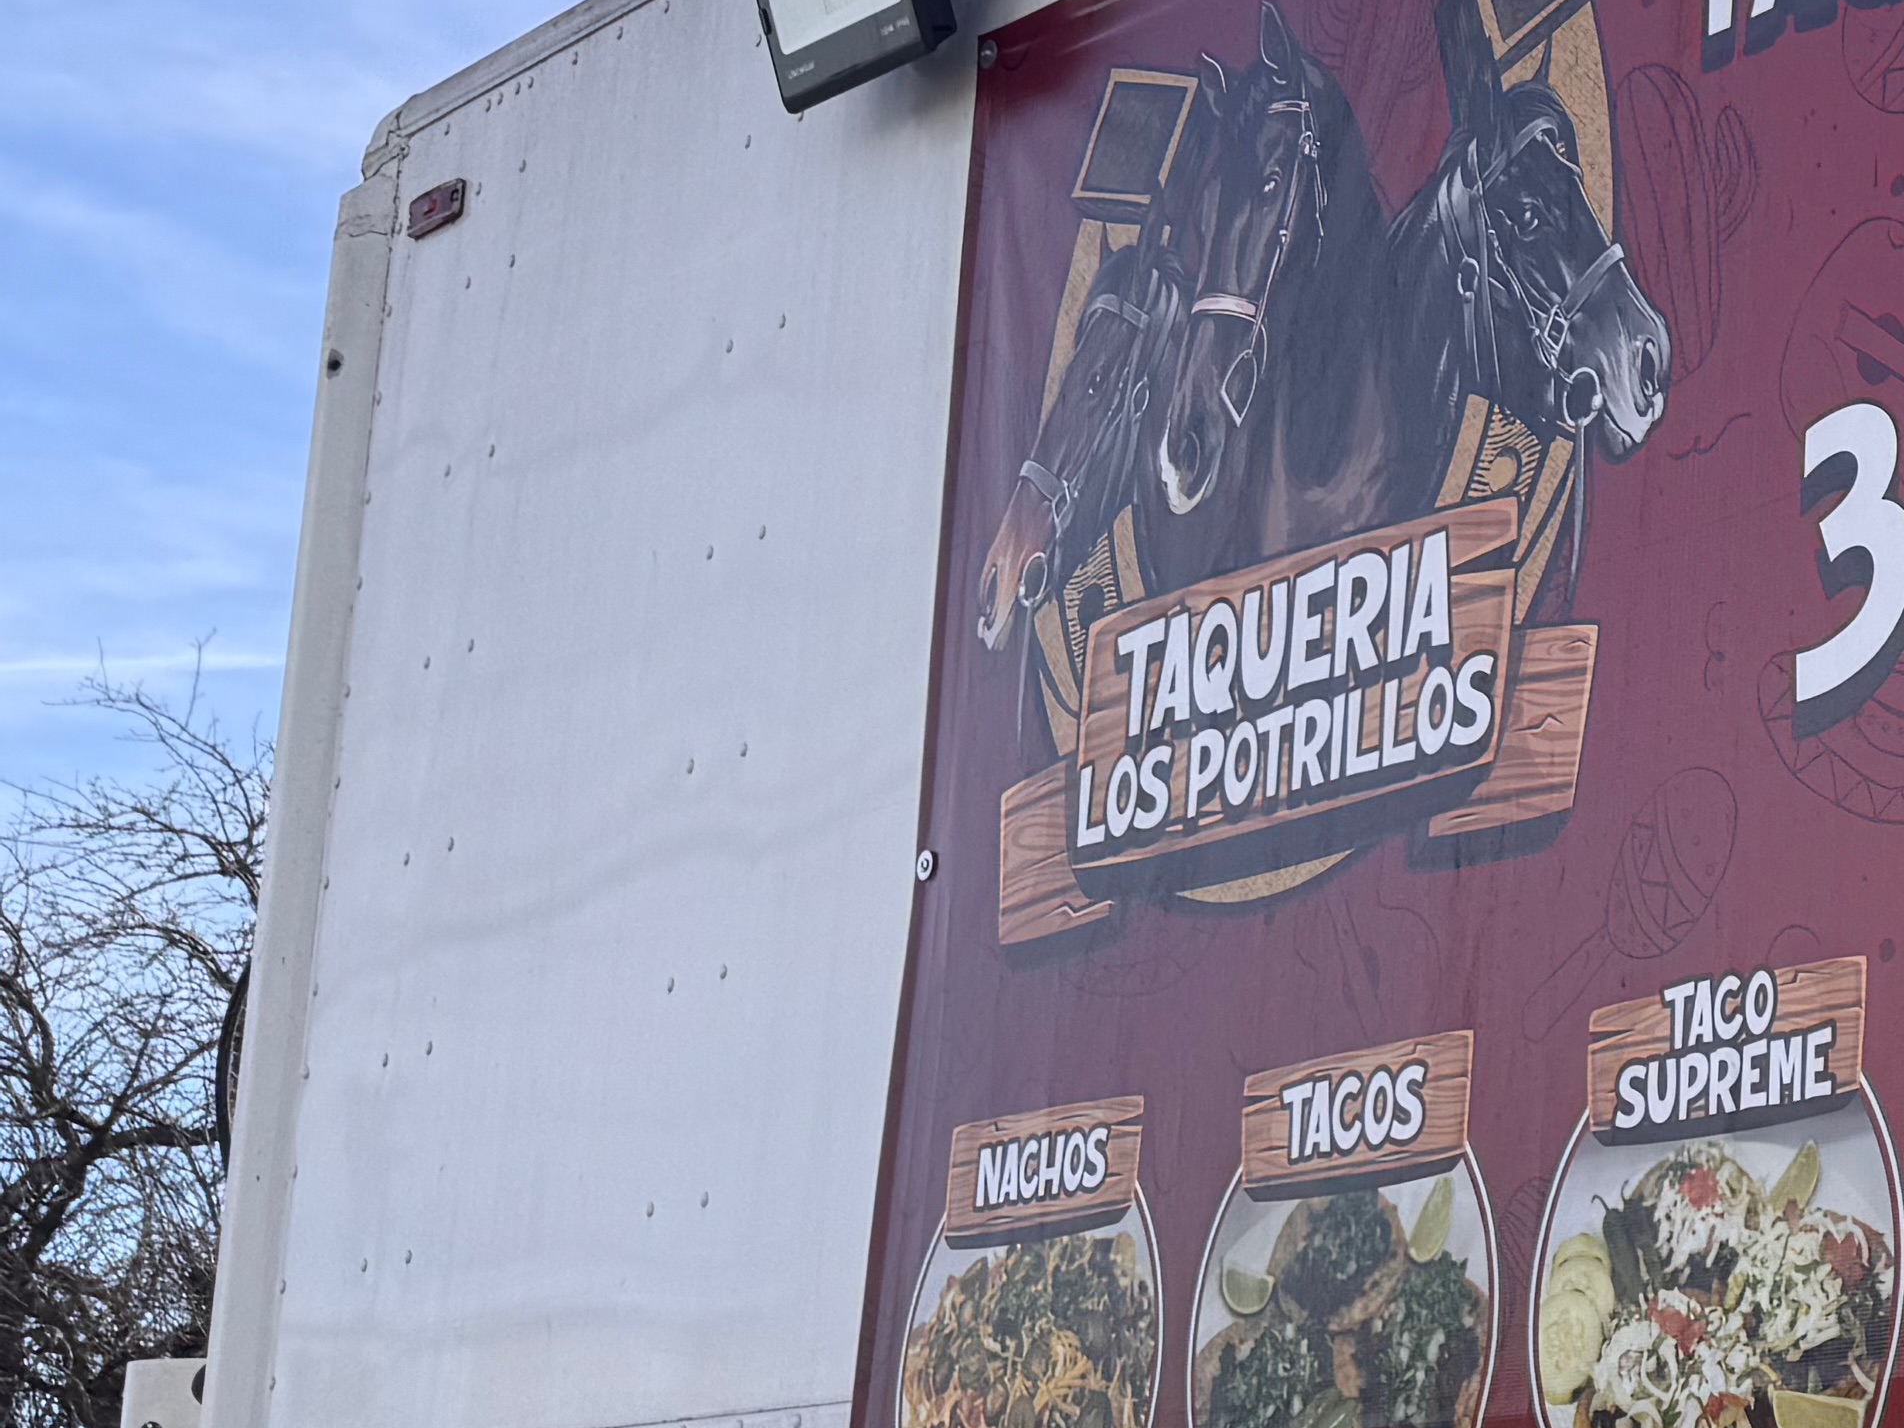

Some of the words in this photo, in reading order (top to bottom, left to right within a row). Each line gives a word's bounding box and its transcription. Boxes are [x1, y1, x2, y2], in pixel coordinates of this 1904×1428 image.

[1118, 532, 1449, 736] TAQUERIA
[1077, 746, 1171, 847] LOS
[1188, 655, 1493, 817] POTRILLOS
[1664, 971, 1773, 1049] TACO
[1283, 1066, 1424, 1158] TACOS
[1616, 1027, 1831, 1128] SUPREME
[976, 1128, 1107, 1206] NACHOS
